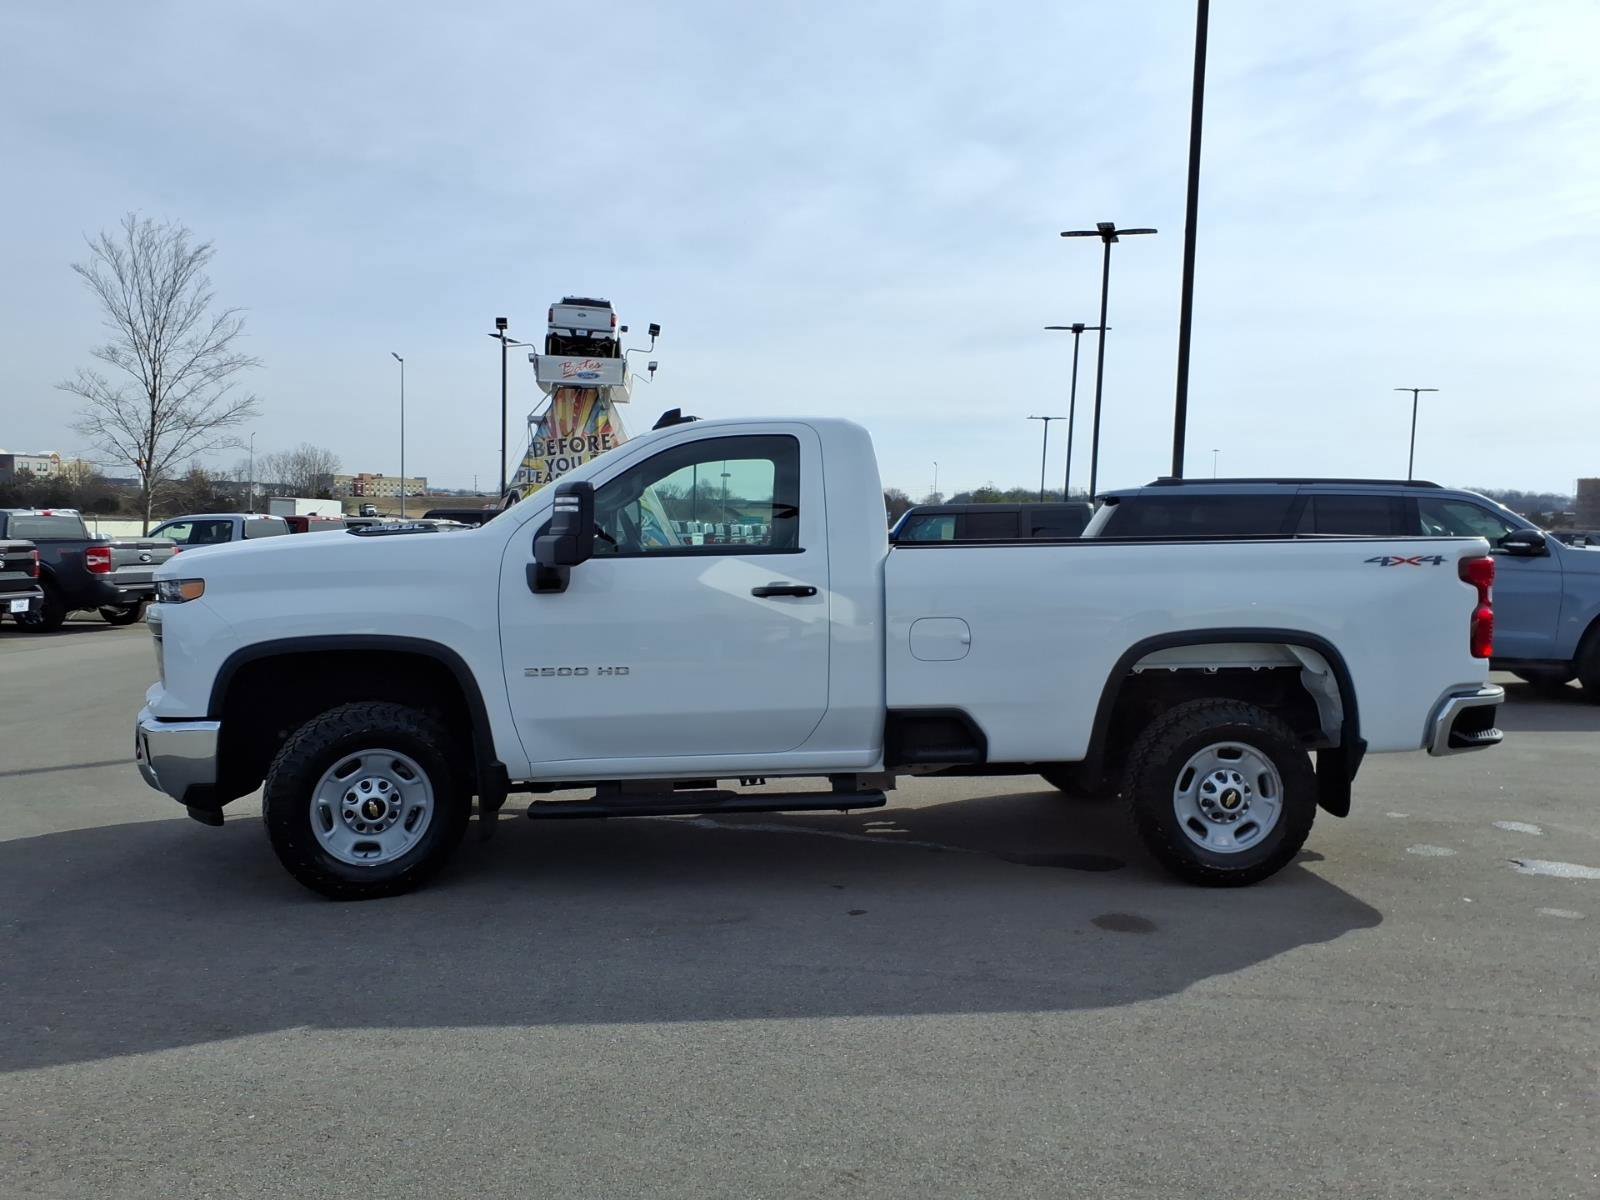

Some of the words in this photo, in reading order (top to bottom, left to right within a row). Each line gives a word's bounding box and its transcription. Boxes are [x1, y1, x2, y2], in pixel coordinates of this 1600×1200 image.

[532, 433, 612, 458] BEFORE
[524, 667, 589, 677] 2500
[597, 666, 630, 676] HD
